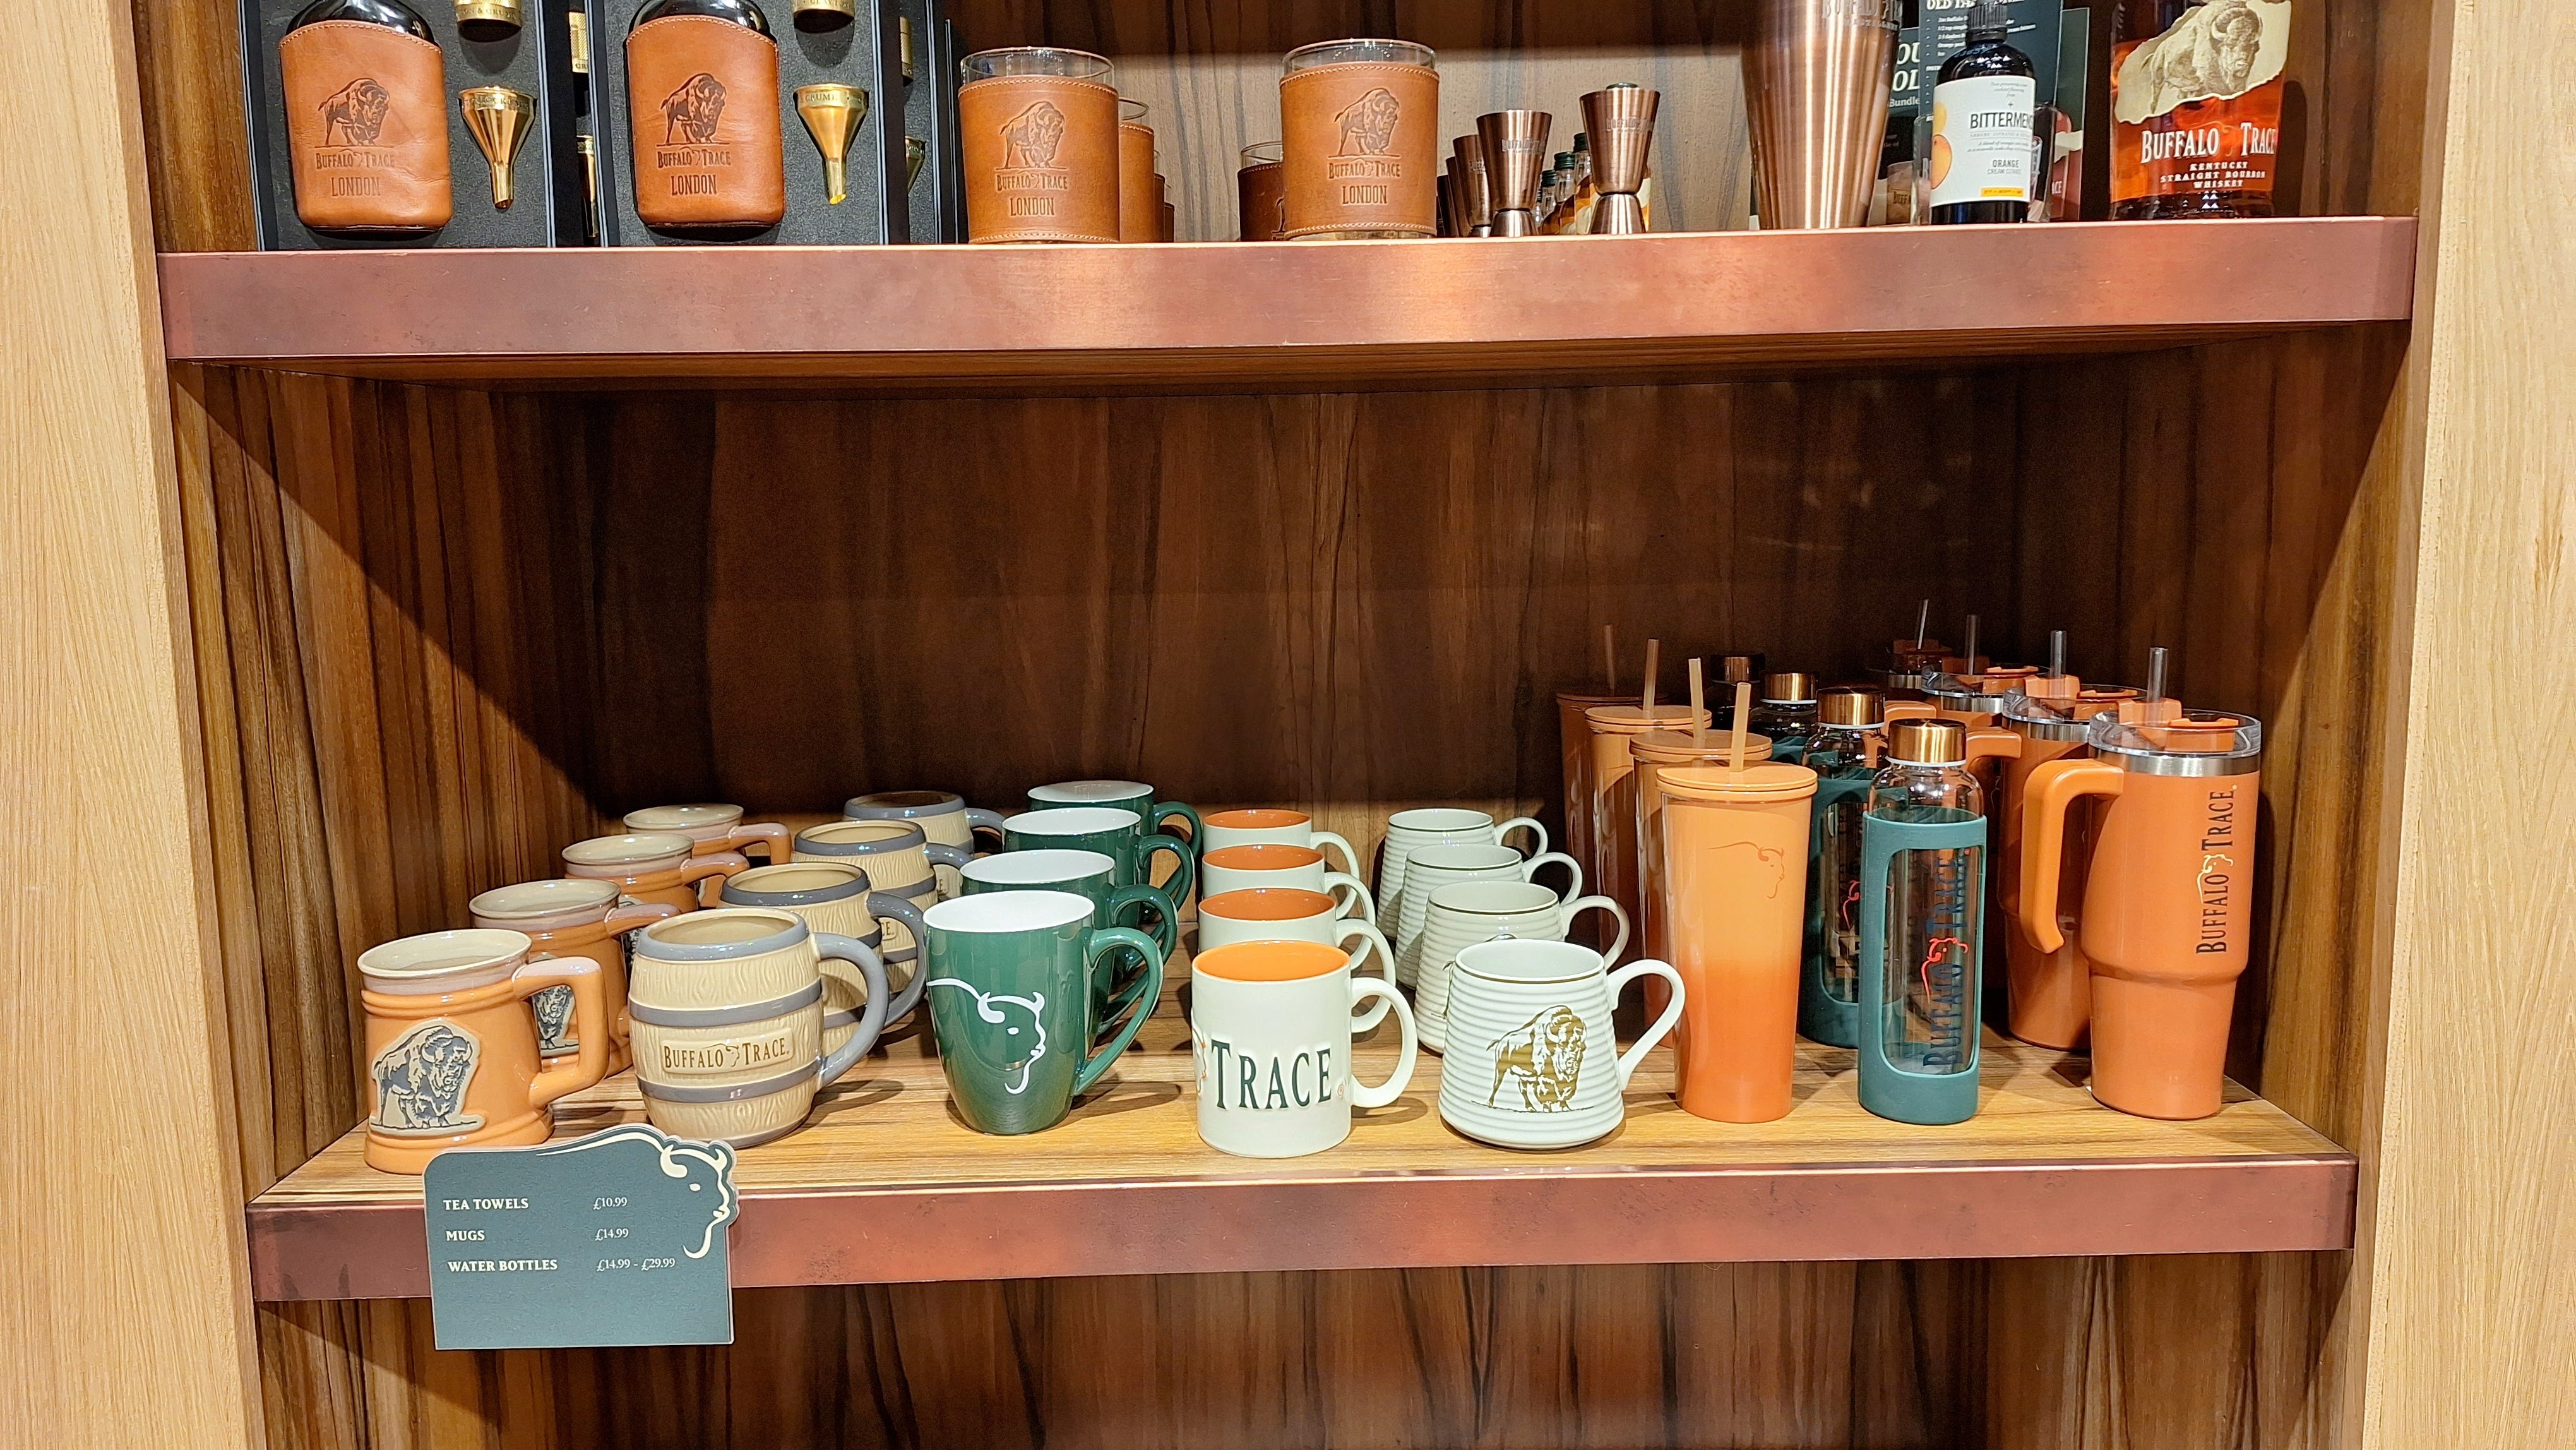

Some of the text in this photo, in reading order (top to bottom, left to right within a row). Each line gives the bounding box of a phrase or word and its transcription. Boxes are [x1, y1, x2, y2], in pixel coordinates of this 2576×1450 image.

[2140, 128, 2220, 164] BUFFALO
[316, 152, 395, 170] BUFFALO TRACE
[657, 148, 731, 169] BUFFALO TRACE
[1992, 159, 2020, 168] ORANGE
[2189, 161, 2248, 172] KENTUCKY
[1328, 160, 1400, 179] BUFFALO TRACE
[2159, 171, 2266, 183] STRAIGHT BOURBON
[331, 177, 381, 197] LONDON
[671, 174, 717, 196] LONDON
[996, 172, 1068, 191] BUFFALO TRACE
[2193, 179, 2244, 189] WHISKEY
[1342, 185, 1388, 205] LONDON
[1010, 197, 1055, 217] LONDON
[2195, 874, 2229, 954] BUFFALO
[1923, 961, 1963, 1067] BUFFALO
[664, 1045, 724, 1069] BUFFALO
[1210, 1038, 1332, 1111] TRACE
[443, 1197, 628, 1211] TEA TOWELS £10.99
[445, 1228, 629, 1242] MUGS £14.99
[447, 1261, 496, 1273] WATER
[498, 1259, 558, 1271] BOTTLES
[596, 1258, 631, 1272] £14.99
[641, 1257, 676, 1271] £29.99
